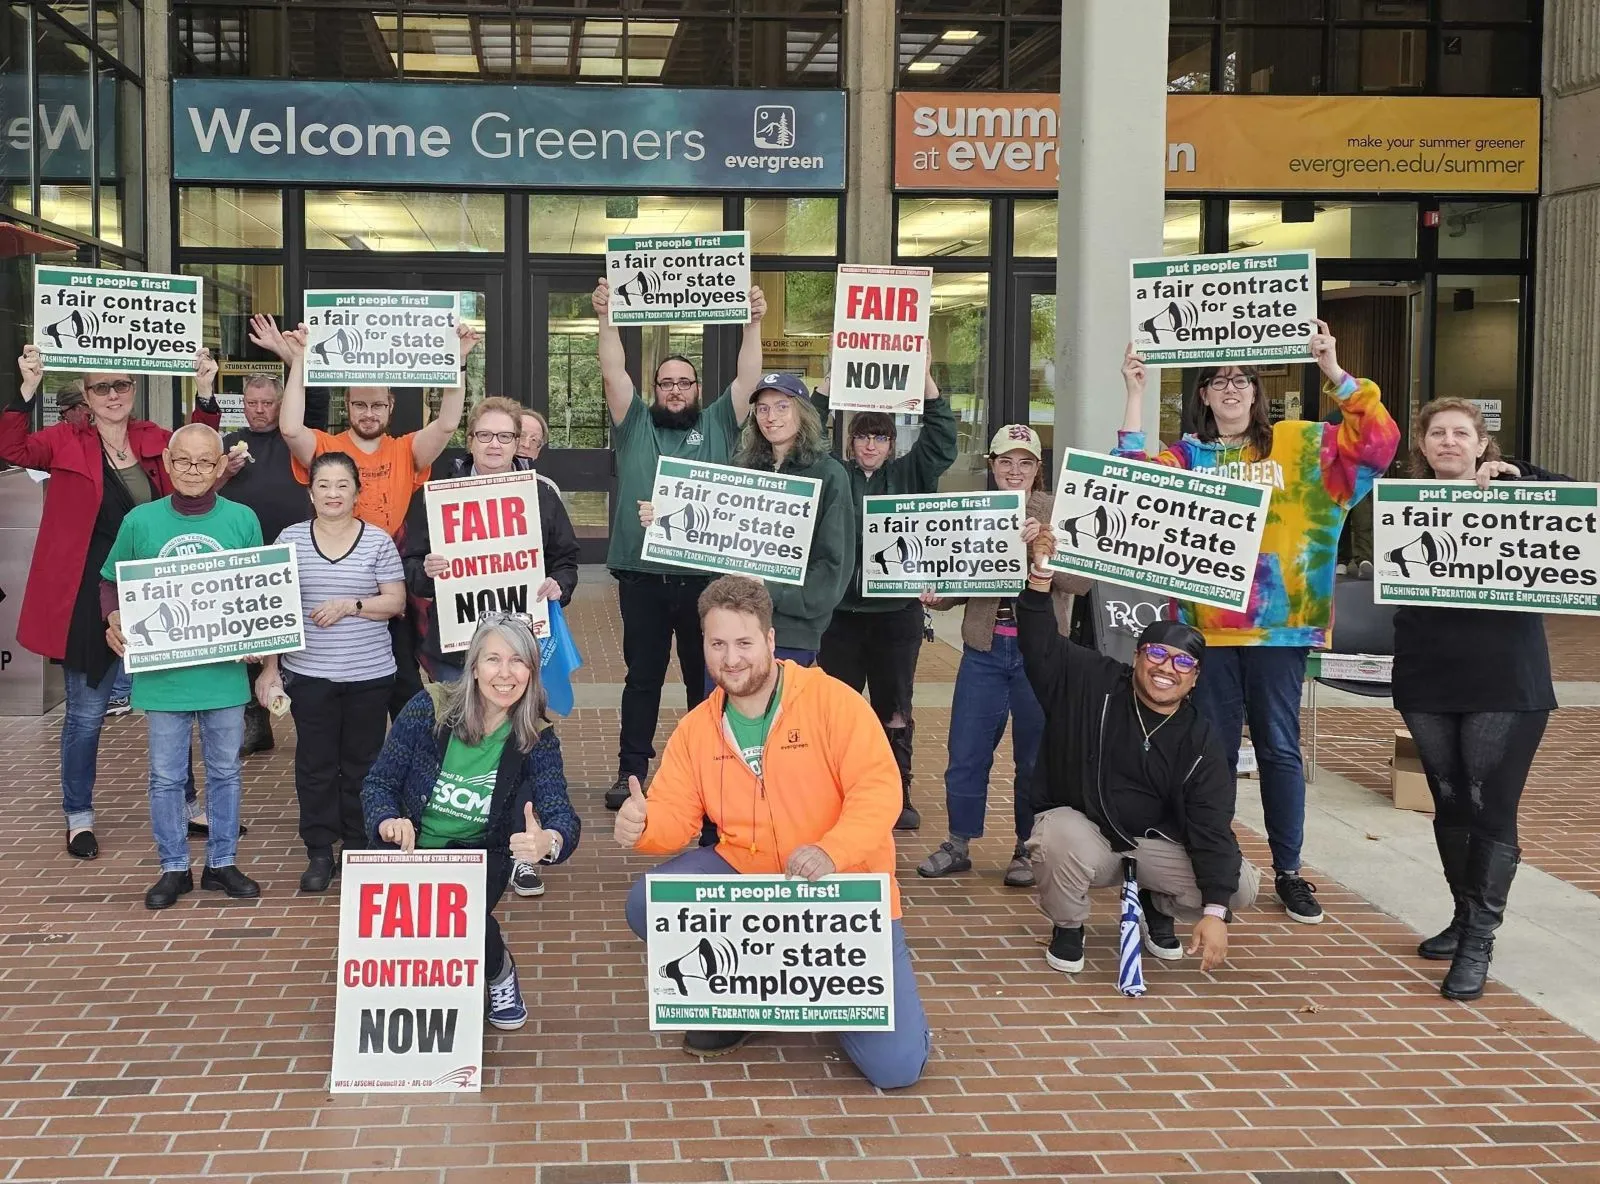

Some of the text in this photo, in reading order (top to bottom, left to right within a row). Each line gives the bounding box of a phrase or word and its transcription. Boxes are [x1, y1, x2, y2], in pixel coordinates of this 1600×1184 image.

[913, 105, 1060, 137] summ
[188, 106, 706, 161] Welcome Greeners
[1347, 135, 1525, 151] make your summer greener
[725, 154, 824, 173] evergreen
[913, 141, 1196, 180] at evern
[1289, 153, 1525, 178] evergreen.edu/summer
[635, 237, 720, 250] put people first!
[611, 251, 745, 269] a fair contract
[1166, 257, 1277, 276] put people first!
[71, 275, 170, 290] put people first!
[661, 270, 736, 287] for state
[1136, 273, 1309, 299] a fair contract
[40, 288, 196, 314] a fair contract
[336, 295, 429, 307] put people first!
[642, 288, 746, 308] employees
[847, 285, 919, 322] FAIR
[1200, 299, 1297, 319] for state
[101, 311, 186, 334] for state
[309, 309, 454, 327] a fair contract
[77, 333, 196, 356] employees
[364, 328, 444, 348] for state
[836, 332, 924, 352] CONTRACT
[1175, 321, 1311, 345] employees
[343, 348, 455, 369] employees
[846, 362, 910, 390] NOW
[1484, 402, 1498, 410] Hall
[689, 469, 787, 490] put people first!
[1102, 464, 1227, 497] put people first!
[658, 481, 810, 518] a fair contract
[895, 497, 991, 512] put people first!
[1063, 478, 1257, 532] a fair contract
[1419, 487, 1557, 503] put people first!
[441, 496, 528, 544] FAIR
[712, 507, 795, 539] for state
[869, 513, 1018, 533] a fair contract
[1382, 505, 1596, 533] a fair contract
[686, 528, 803, 560] employees
[924, 535, 1008, 554] for state
[1131, 512, 1236, 555] for state
[1097, 535, 1246, 581] employees
[1460, 532, 1580, 560] for state
[154, 553, 261, 577] put people first!
[902, 555, 1020, 578] employees
[1429, 559, 1597, 588] employees
[125, 566, 292, 603] a fair contract
[1382, 584, 1597, 606] WASHINGTON FEDERATION OF STATE EMPLOYEES/AFSCME
[190, 593, 282, 615] for state
[455, 584, 528, 624] NOW
[167, 613, 297, 642] employees
[1, 651, 12, 671] P
[432, 802, 472, 821] Washington
[695, 883, 840, 901] put people first!
[358, 883, 468, 938] FAIR
[655, 907, 882, 933] a fair contract
[740, 938, 866, 967] for state
[343, 958, 479, 988] CONTRACT
[708, 969, 884, 1002] employees
[658, 1006, 885, 1021] WASHINGTON FEDERATION OF STATE EMPLOYEES/AFSCME
[358, 1008, 459, 1054] NOW
